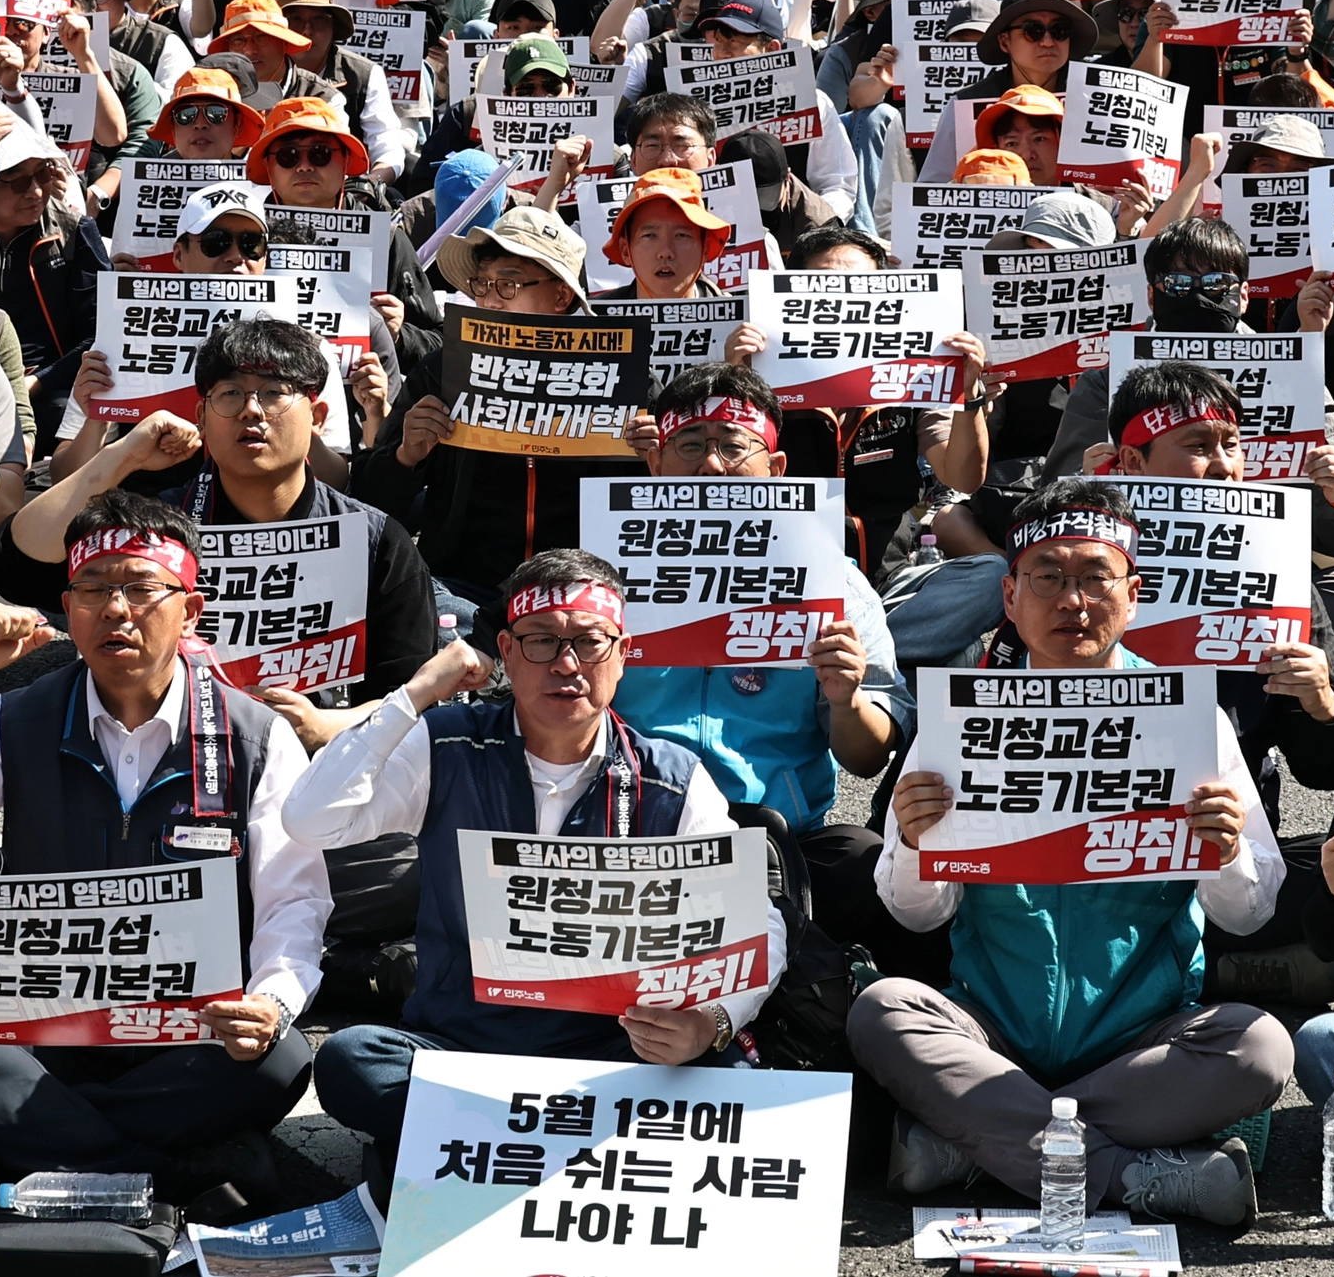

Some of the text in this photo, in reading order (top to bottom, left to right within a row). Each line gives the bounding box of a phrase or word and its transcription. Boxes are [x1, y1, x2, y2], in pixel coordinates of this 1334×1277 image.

[468, 322, 623, 352] 가자! 노동자 시대!
[974, 677, 1171, 706] 열사의 염원이다!
[954, 770, 1175, 813] 노동기본권
[517, 838, 722, 870] 열사의 염원이다!
[949, 862, 991, 872] 민주노총
[1084, 819, 1205, 872] 쟁취!
[72, 871, 192, 908] 염원이다!
[505, 916, 724, 963] 노동기본권
[503, 987, 546, 1002] 민주노총
[635, 948, 758, 1013] 쟁취!
[507, 1092, 744, 1144] 5월 1일에
[434, 1139, 807, 1200] 처음 쉬는 사람
[520, 1199, 708, 1249] 나야 나
